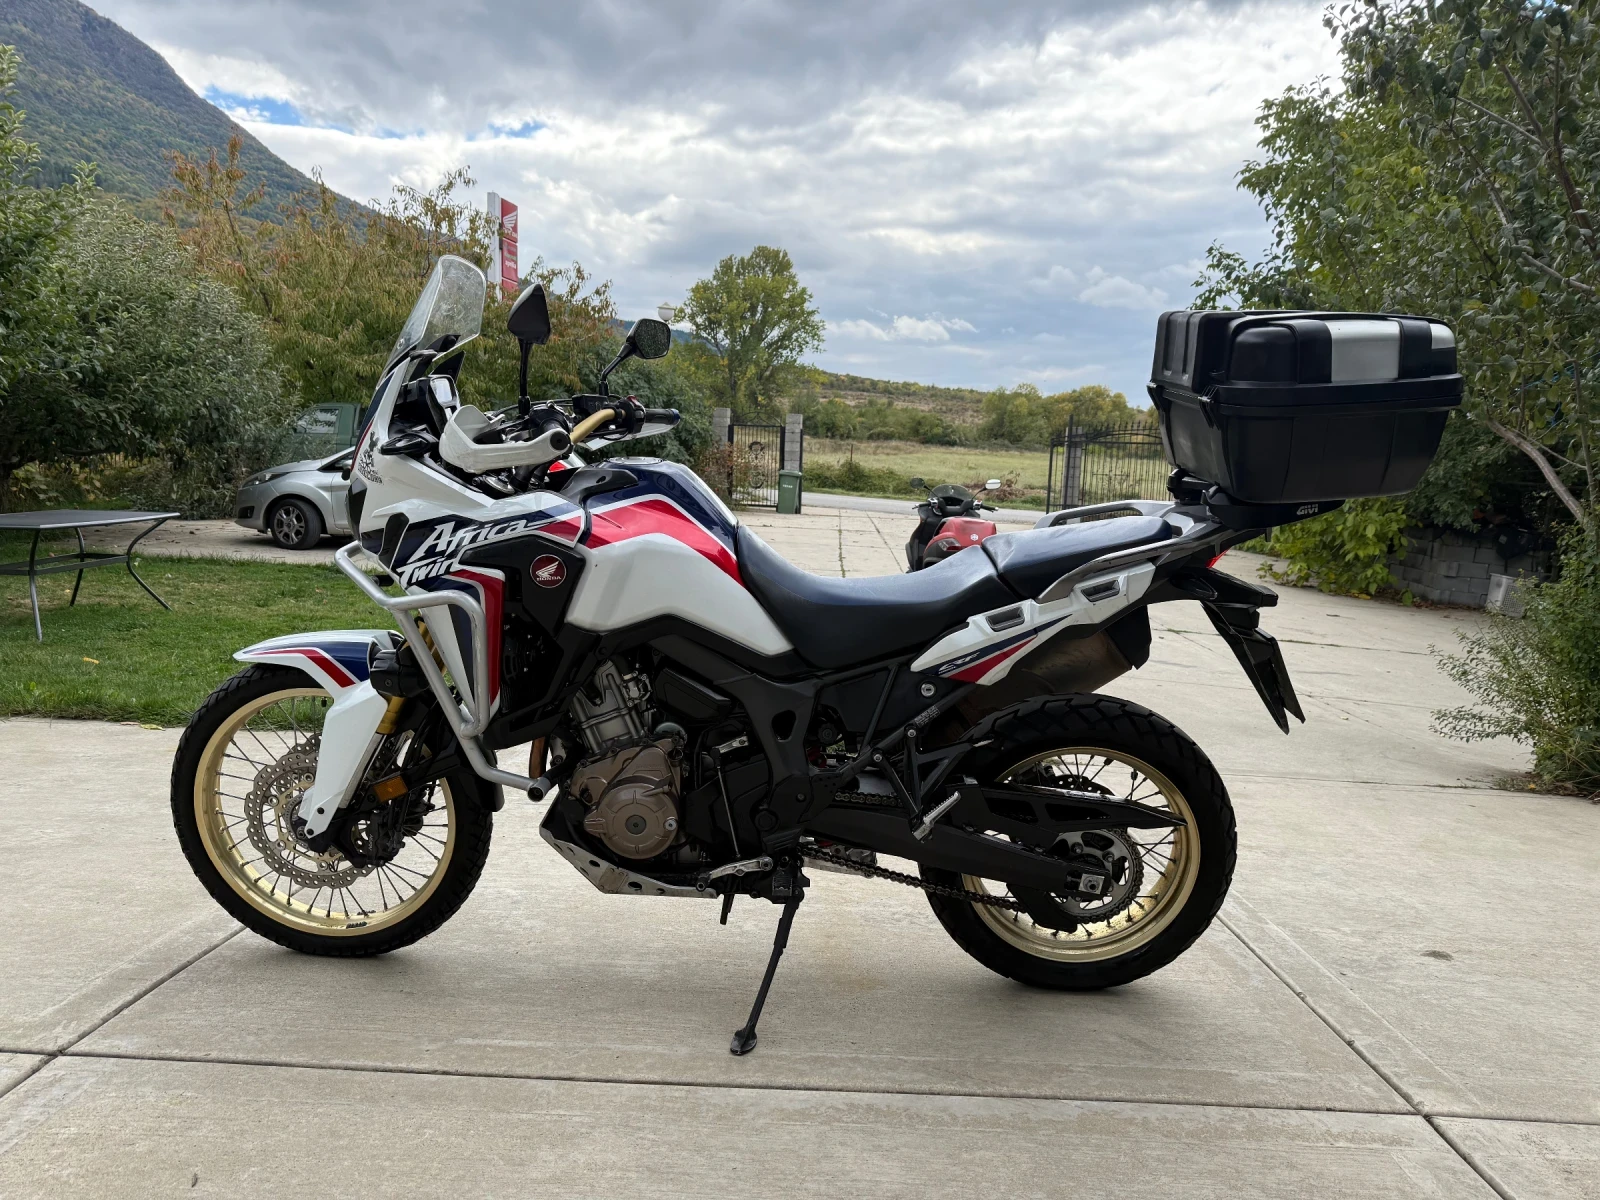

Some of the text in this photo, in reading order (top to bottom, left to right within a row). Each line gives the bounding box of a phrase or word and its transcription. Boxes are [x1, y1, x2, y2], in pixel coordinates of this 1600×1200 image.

[1296, 503, 1319, 516] GIVI
[406, 519, 550, 565] Africa
[396, 556, 459, 590] Twin
